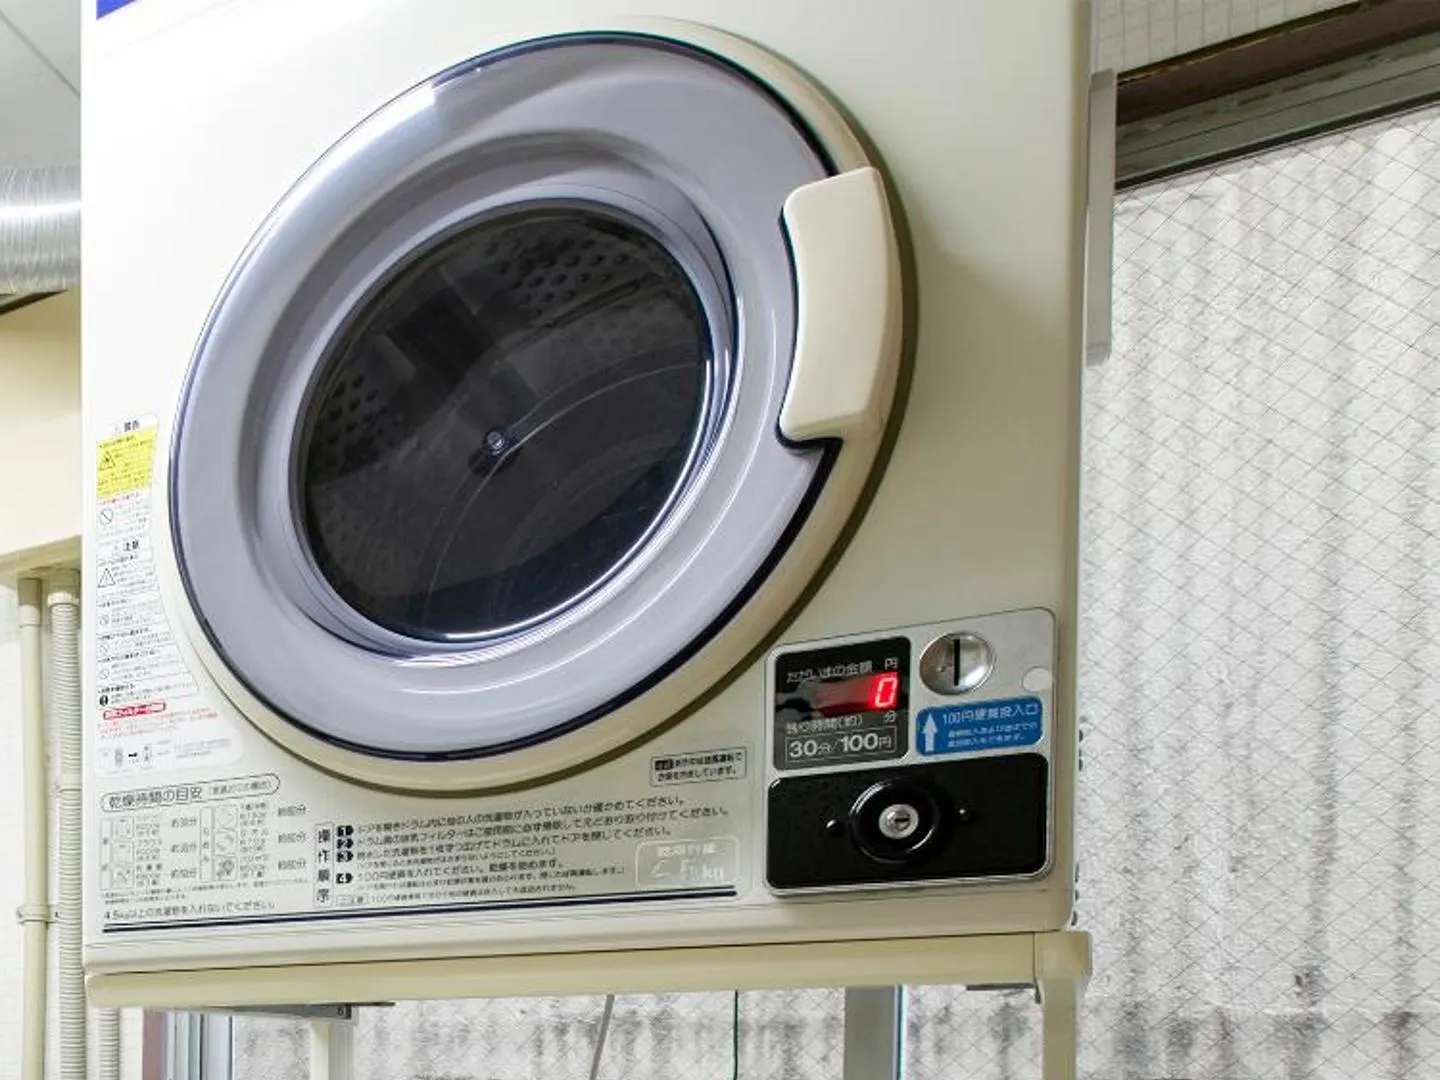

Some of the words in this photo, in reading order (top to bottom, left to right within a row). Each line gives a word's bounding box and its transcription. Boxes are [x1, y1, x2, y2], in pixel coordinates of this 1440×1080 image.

[885, 657, 899, 671] 円
[874, 675, 898, 708] 0
[108, 786, 203, 809] 乾燥時間の目安
